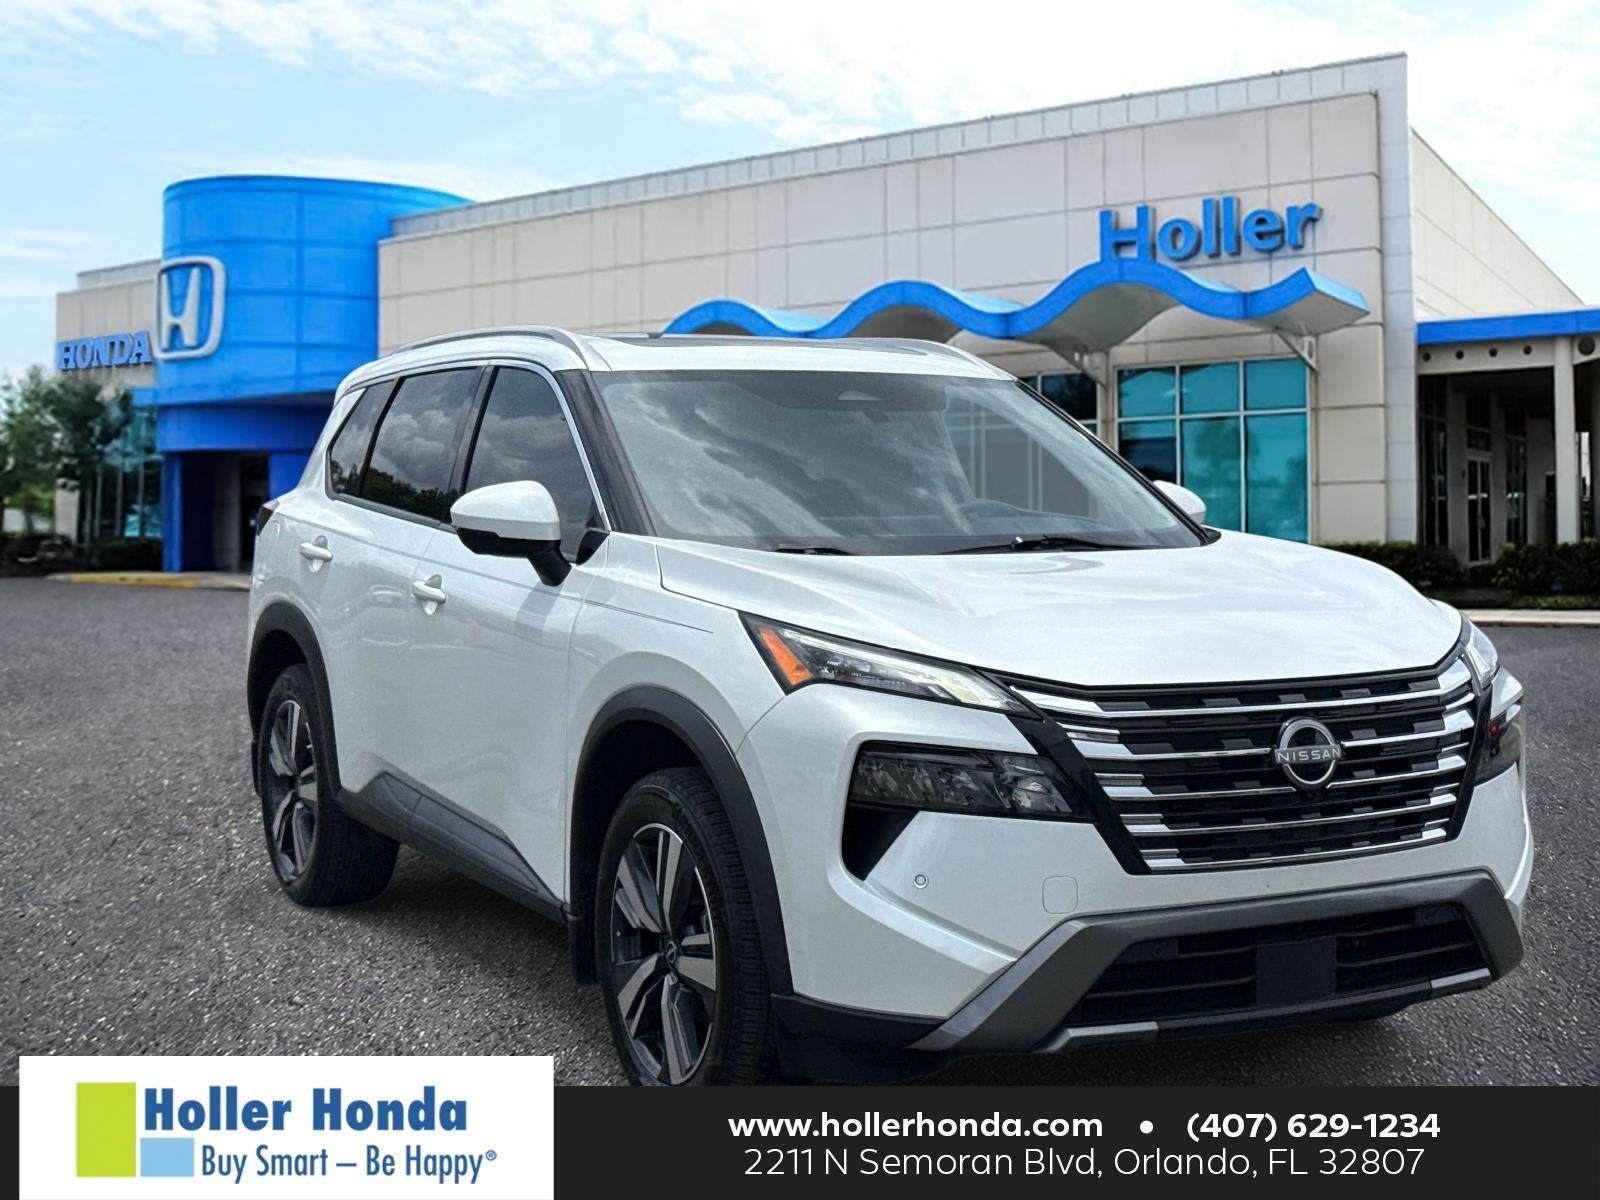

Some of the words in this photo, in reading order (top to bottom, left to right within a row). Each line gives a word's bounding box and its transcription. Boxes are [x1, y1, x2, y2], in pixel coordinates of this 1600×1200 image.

[1099, 196, 1321, 262] Holler
[57, 331, 152, 371] HONDA
[1277, 747, 1341, 763] NISSAN
